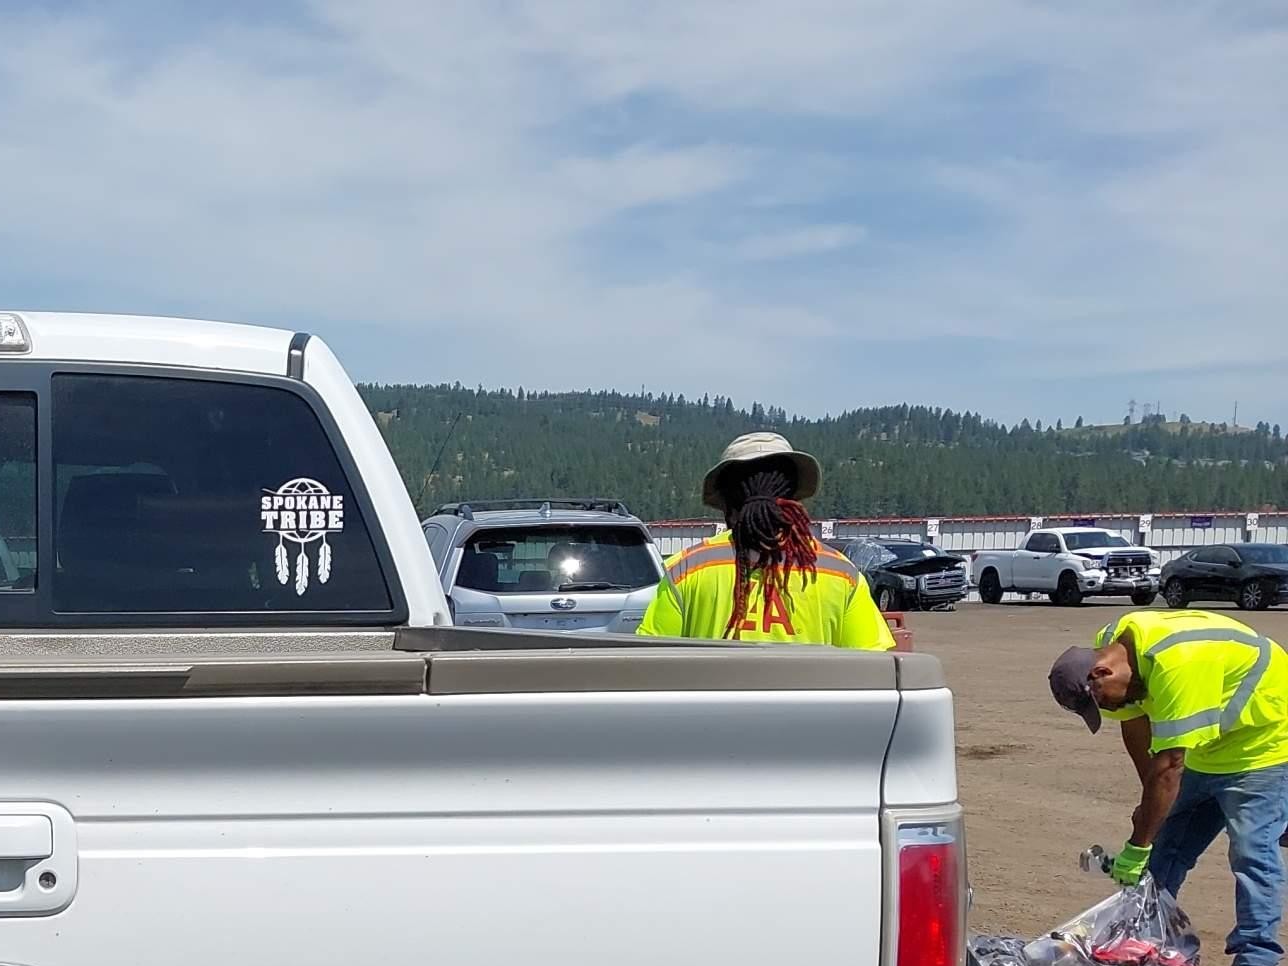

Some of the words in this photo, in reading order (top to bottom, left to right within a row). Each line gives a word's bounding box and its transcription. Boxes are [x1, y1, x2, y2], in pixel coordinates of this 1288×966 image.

[261, 495, 343, 510] SPOKANE
[261, 510, 344, 529] TRIBE
[1139, 519, 1151, 528] 29
[1247, 518, 1258, 526] 30
[927, 523, 938, 532] 27
[1031, 521, 1042, 529] 28
[822, 526, 833, 535] 26
